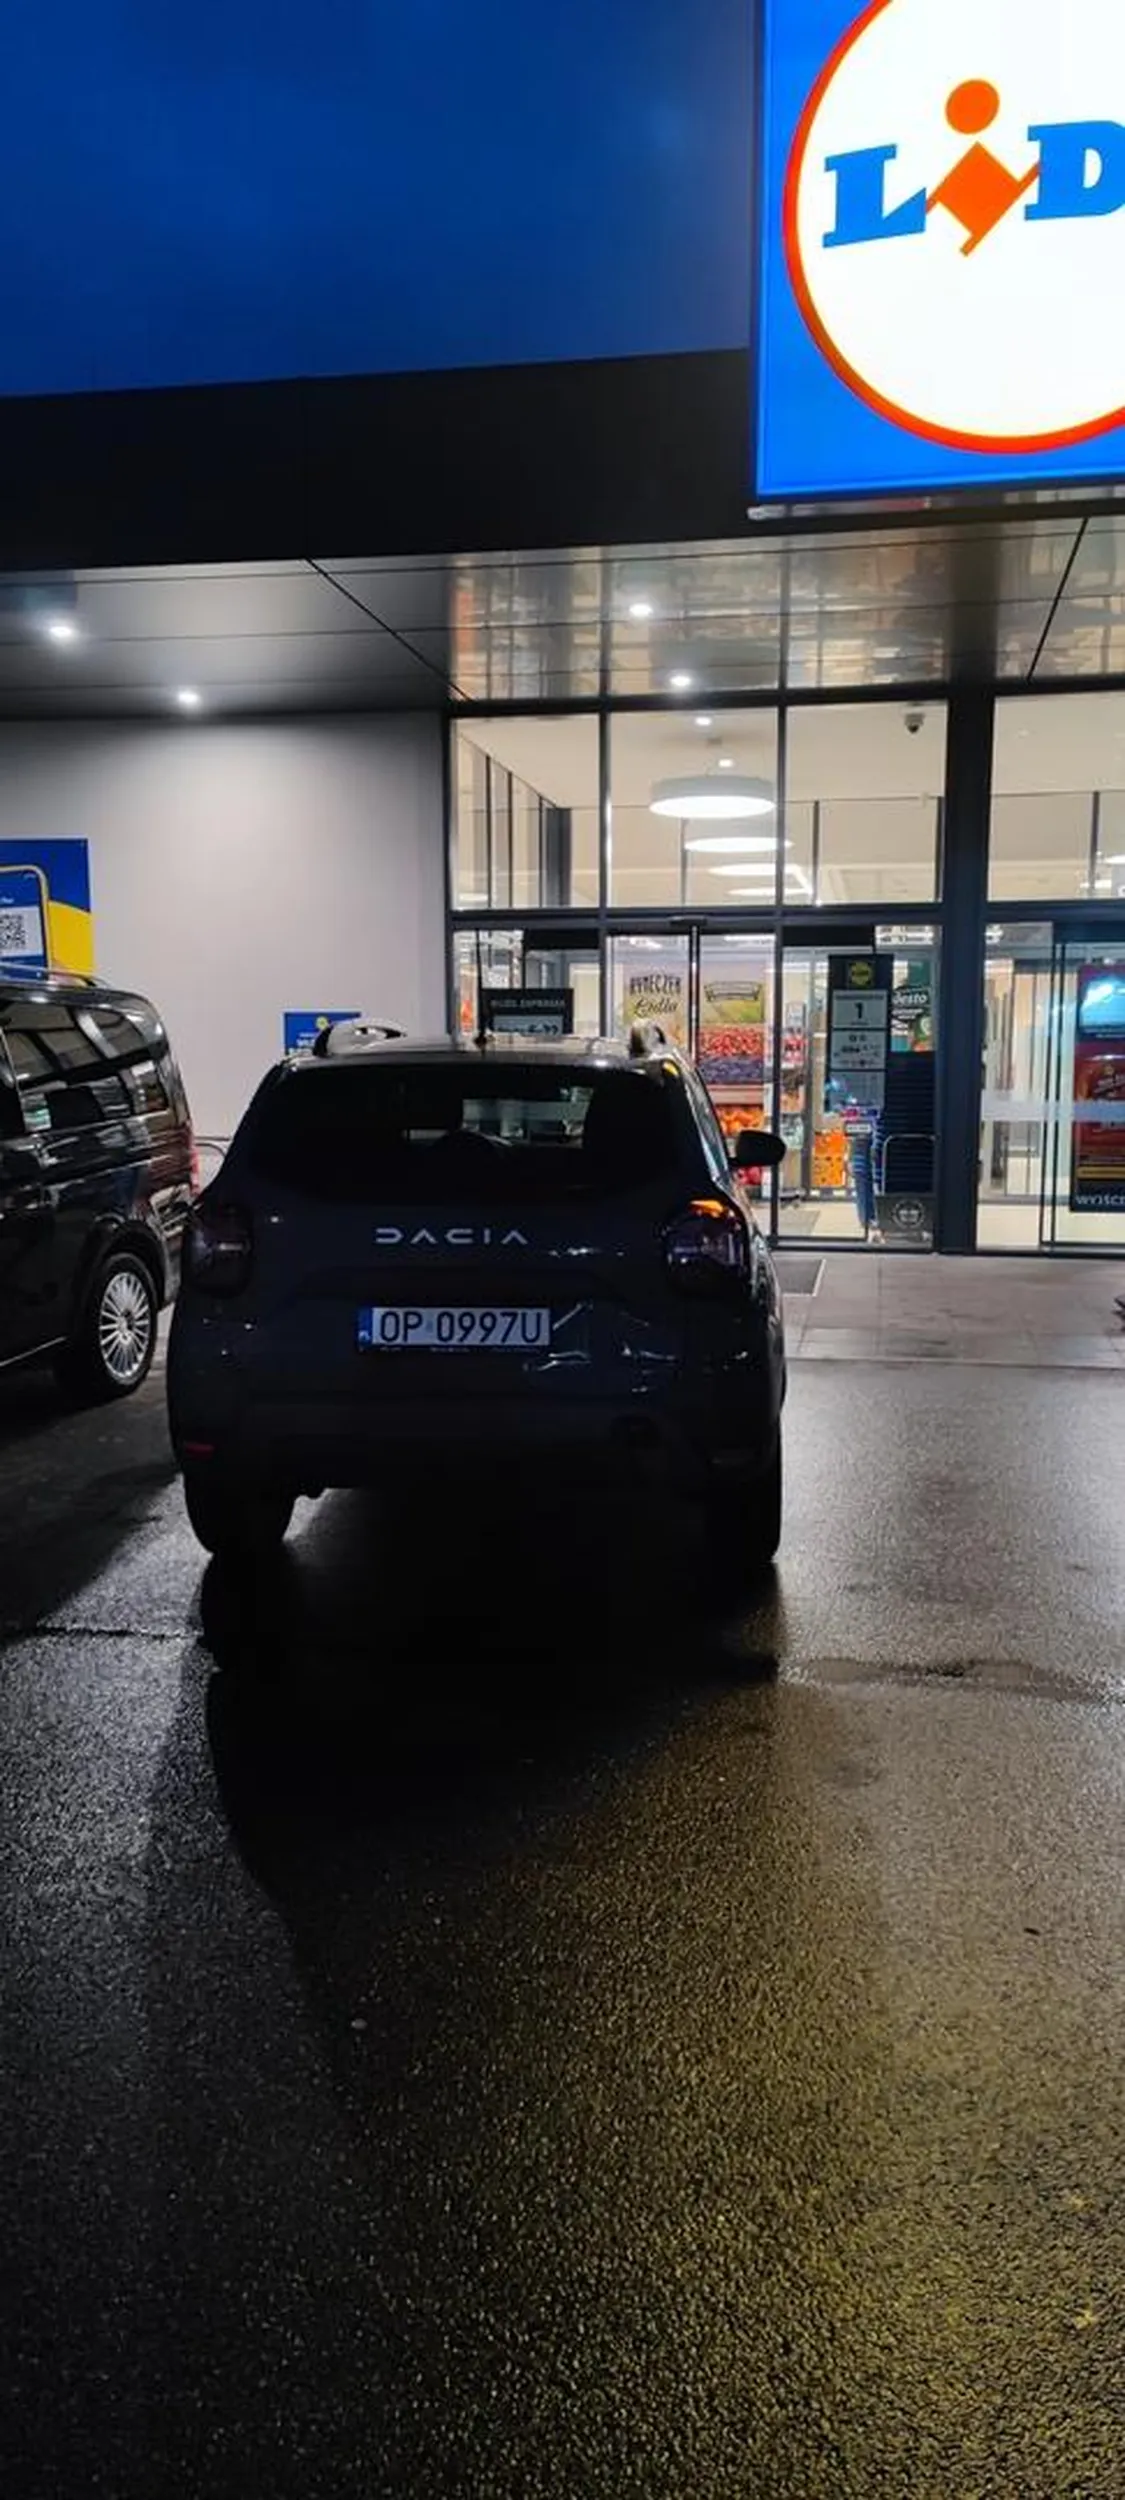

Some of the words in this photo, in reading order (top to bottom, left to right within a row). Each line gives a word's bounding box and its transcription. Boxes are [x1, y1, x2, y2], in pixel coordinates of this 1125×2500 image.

[854, 1002, 863, 1019] 1
[375, 1227, 529, 1245] DACIA
[380, 1311, 423, 1343] OP
[436, 1311, 542, 1344] 0997U
